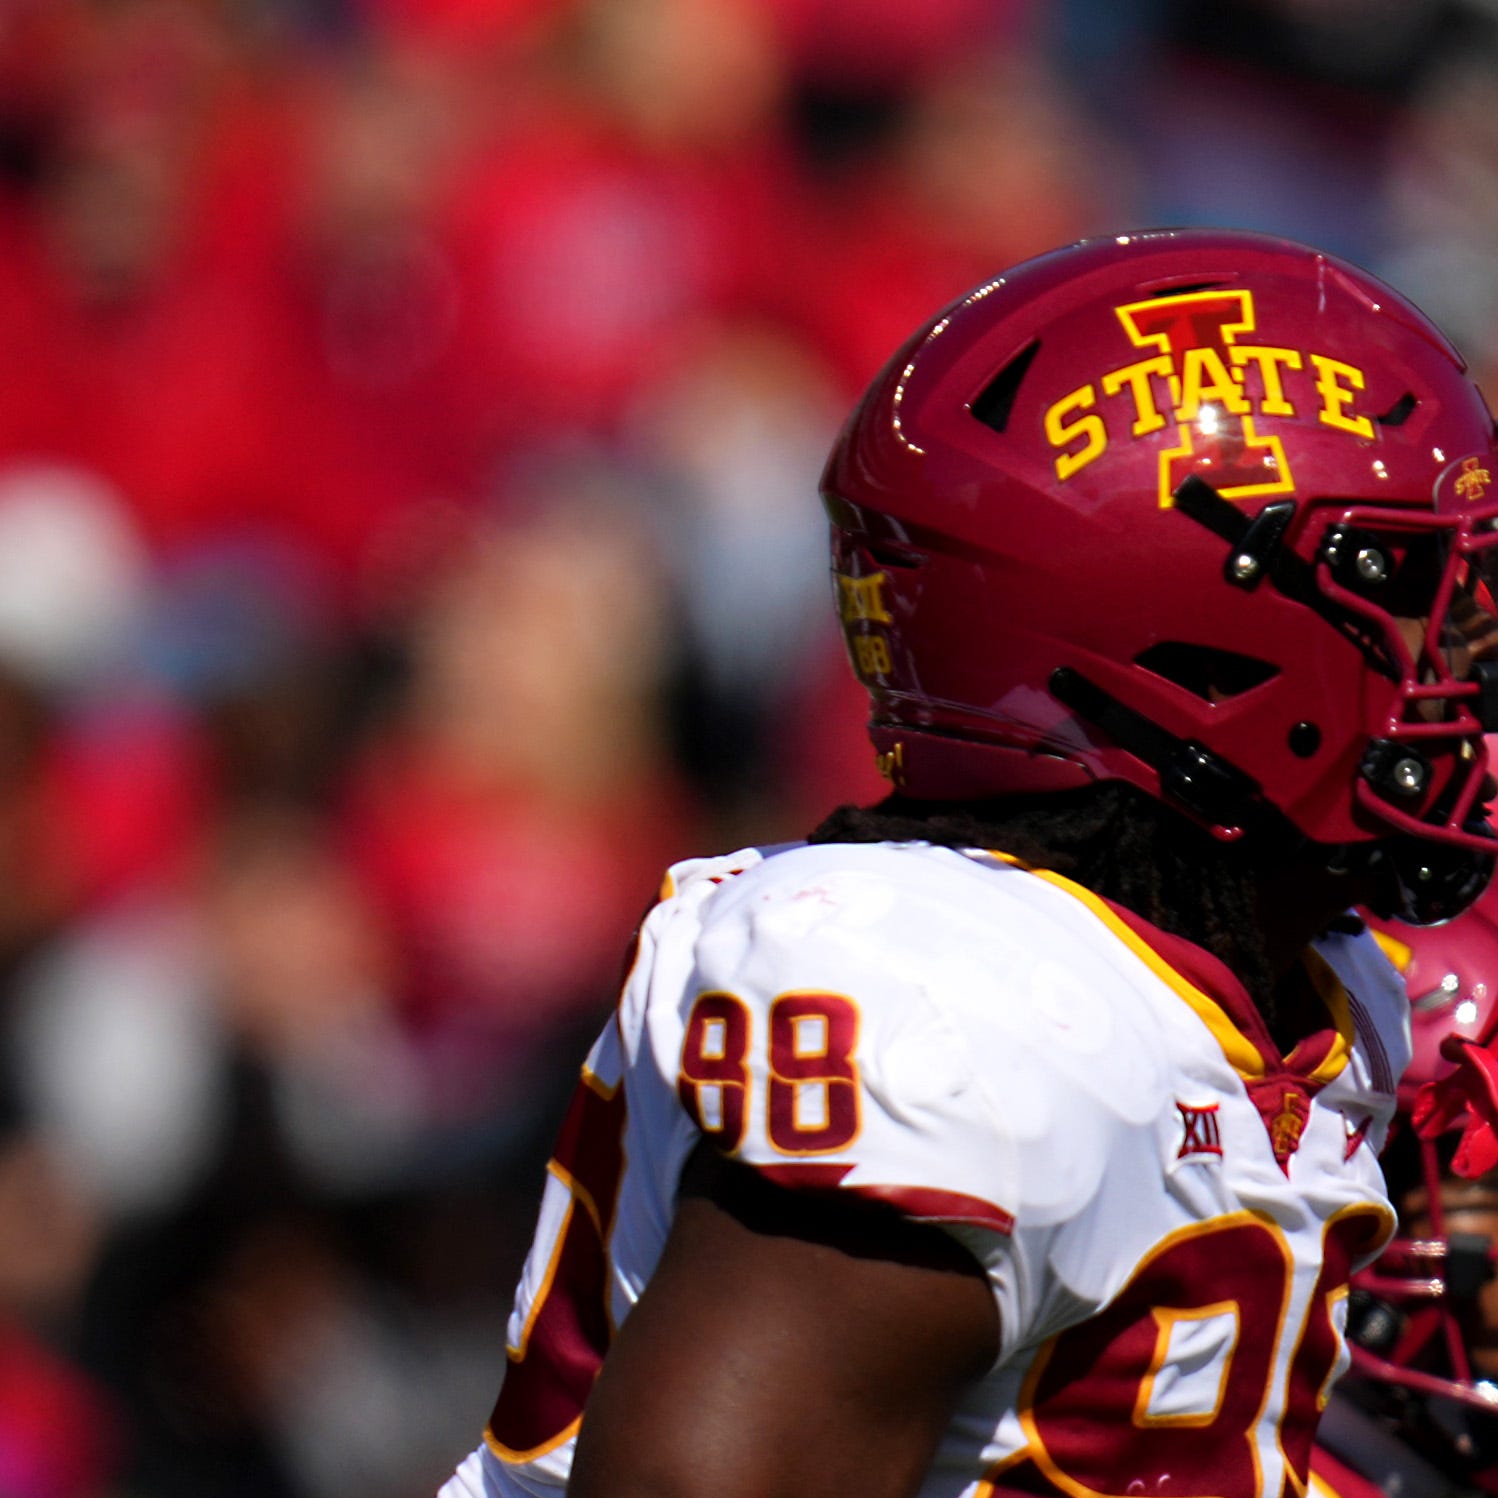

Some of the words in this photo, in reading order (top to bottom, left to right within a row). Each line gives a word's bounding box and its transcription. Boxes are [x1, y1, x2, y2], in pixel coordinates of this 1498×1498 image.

[1044, 345, 1376, 481] STATE
[678, 989, 861, 1157] 88
[1175, 1100, 1224, 1159] XII
